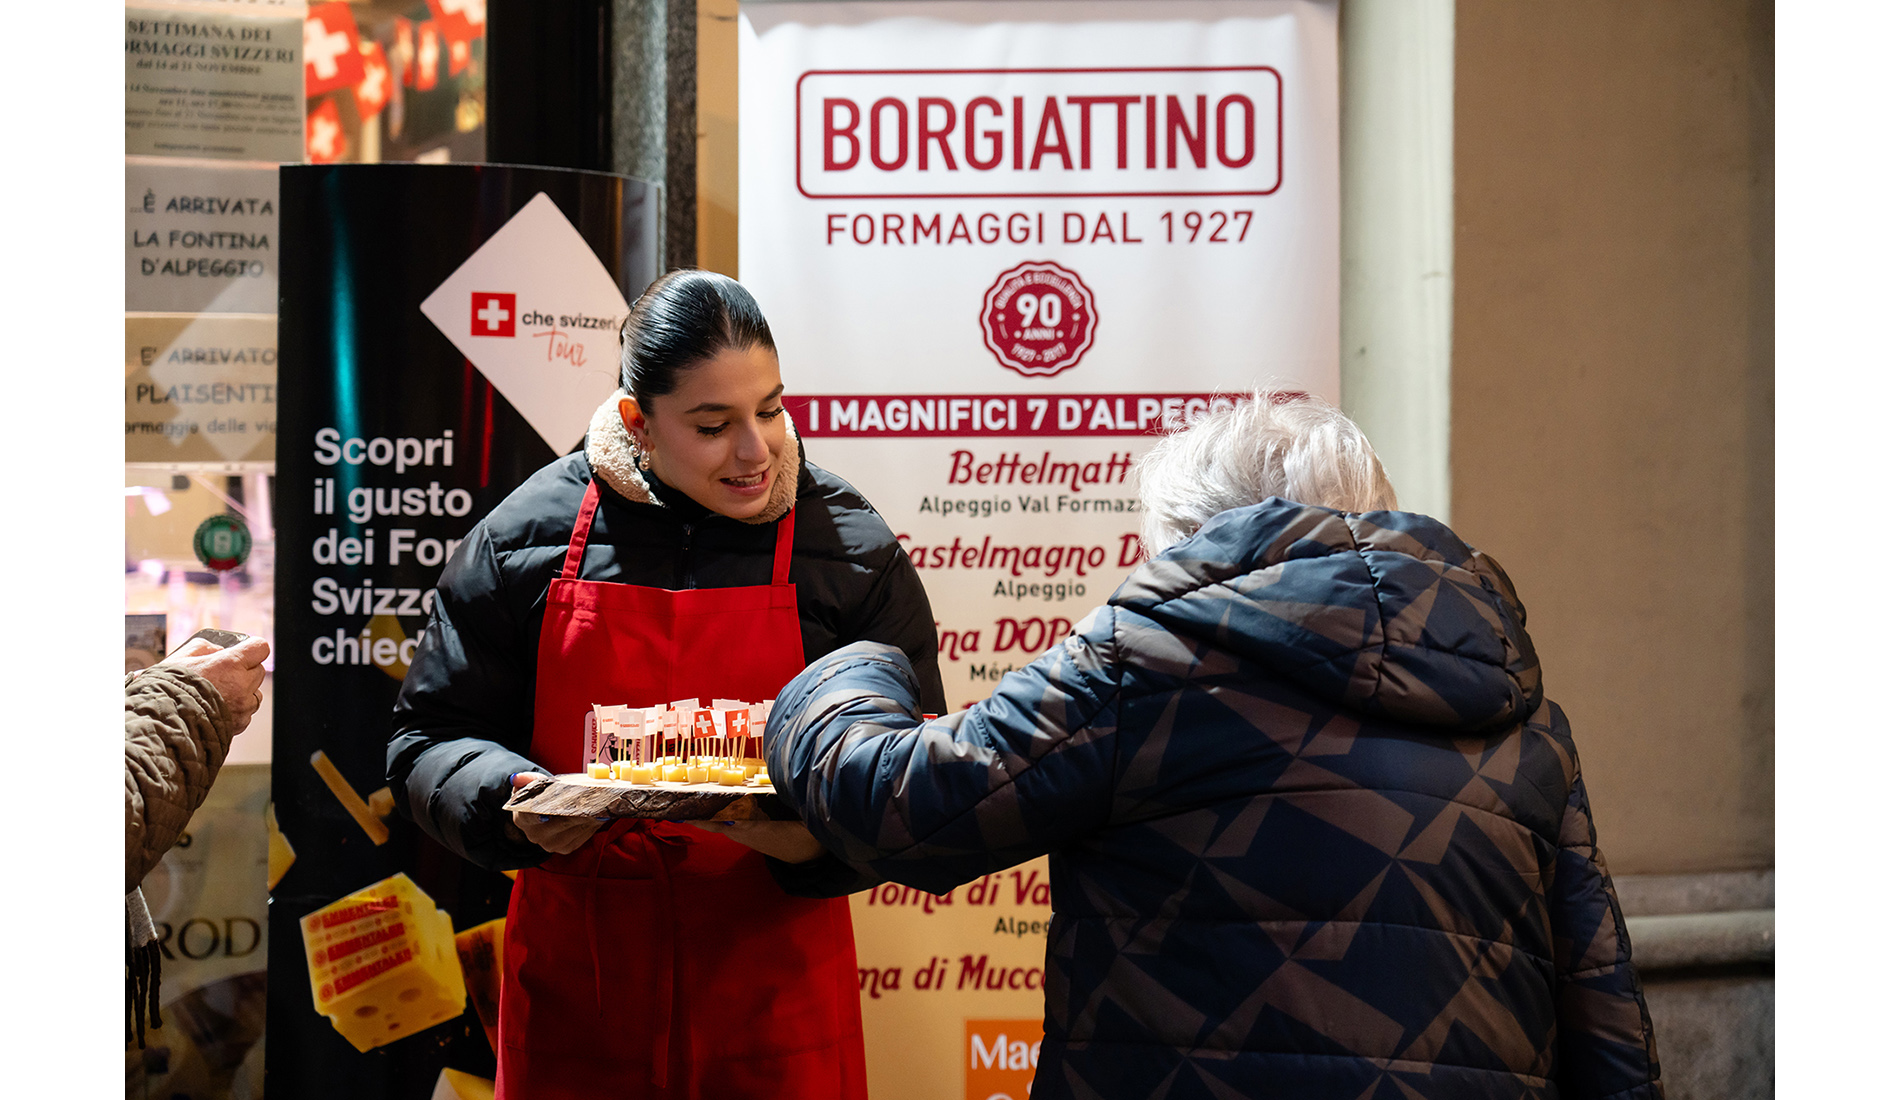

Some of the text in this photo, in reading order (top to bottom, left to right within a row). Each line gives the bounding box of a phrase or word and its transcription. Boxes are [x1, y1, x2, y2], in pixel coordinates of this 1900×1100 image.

[128, 20, 272, 41] SETTIMANA DEI
[125, 40, 294, 63] RMAGGI SVIZZERI
[822, 93, 1256, 172] BORGIATTINO
[166, 196, 273, 215] ARRIVATA
[134, 229, 269, 250] LA FONTINA
[826, 210, 1255, 246] FORMAGGI DAL 1927
[141, 257, 264, 278] D'ALPEGGIO
[521, 310, 554, 327] che
[1016, 293, 1062, 328] 90
[1022, 327, 1056, 341] ANNI
[168, 346, 276, 366] ARRIVATO
[207, 418, 246, 433] delle
[809, 399, 819, 431] I
[830, 398, 1016, 431] MAGNIFICI
[1029, 398, 1049, 431] 7
[313, 427, 454, 475] Scopri
[948, 449, 1132, 492] Bettelmatt
[313, 478, 473, 524] il gusto
[919, 496, 1011, 517] Alpeggio
[1018, 495, 1049, 513] Val
[312, 528, 375, 566] dei
[993, 581, 1086, 600] Alpeggio
[994, 616, 1073, 653] DOP
[966, 875, 1002, 907] di
[914, 956, 949, 991] di
